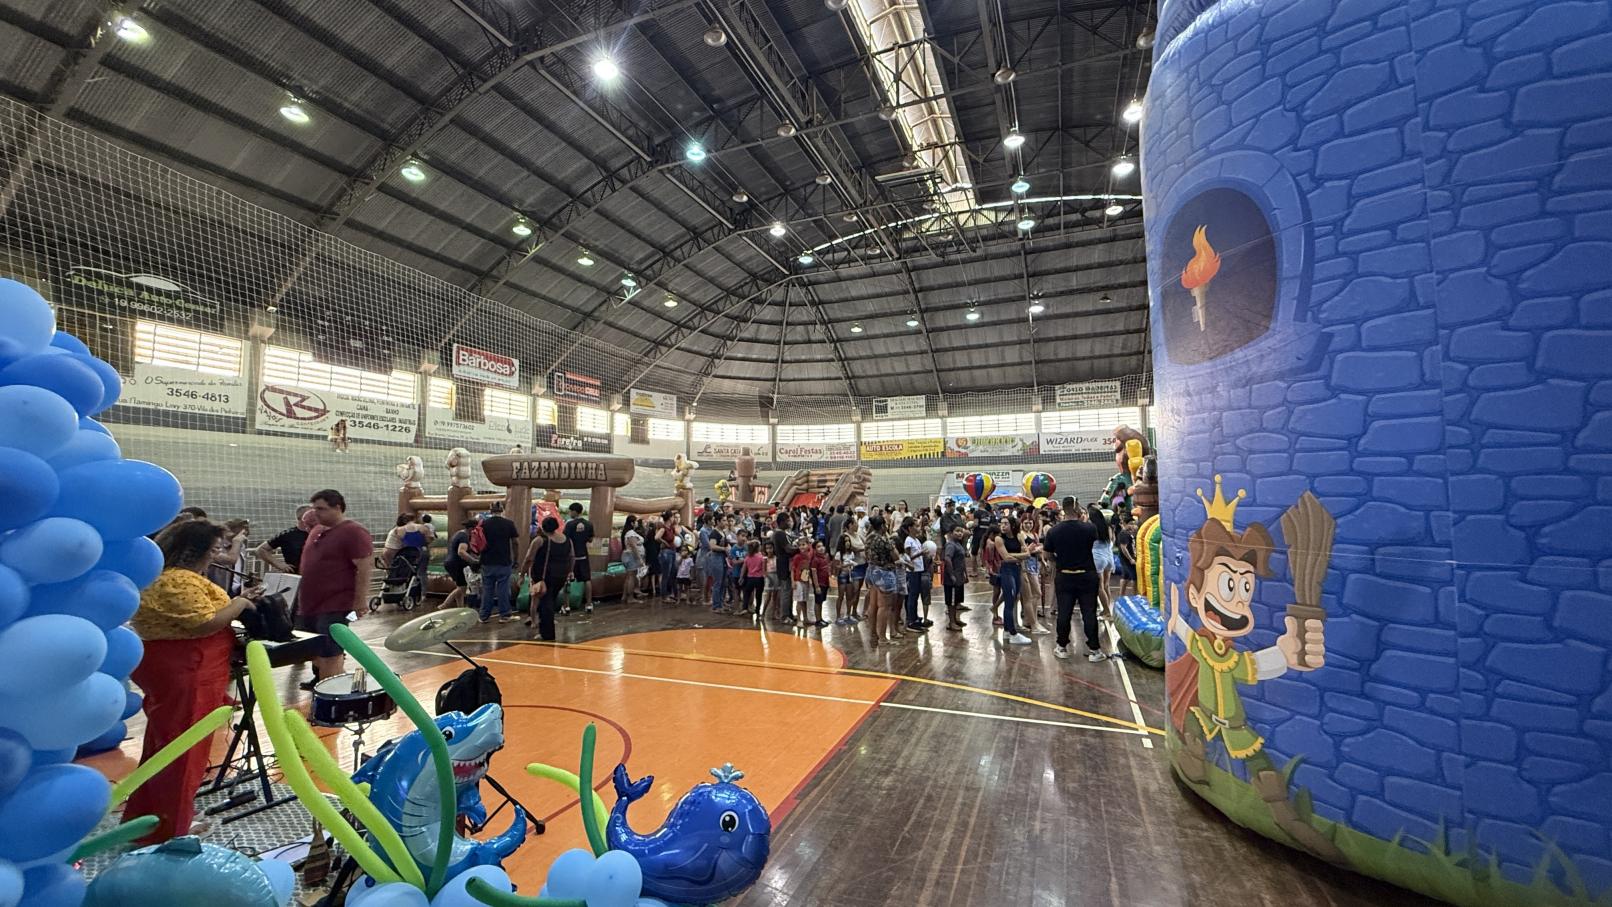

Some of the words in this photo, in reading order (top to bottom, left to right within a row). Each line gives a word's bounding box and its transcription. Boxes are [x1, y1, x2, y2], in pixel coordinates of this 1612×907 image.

[459, 350, 510, 375] Barbosa
[166, 387, 230, 404] 3546-4813
[349, 419, 411, 434] 3546-1226
[1046, 436, 1083, 446] WIZARD
[779, 447, 798, 455] Carol
[800, 447, 822, 455] Festas
[511, 461, 608, 481] FAZENDINHA
